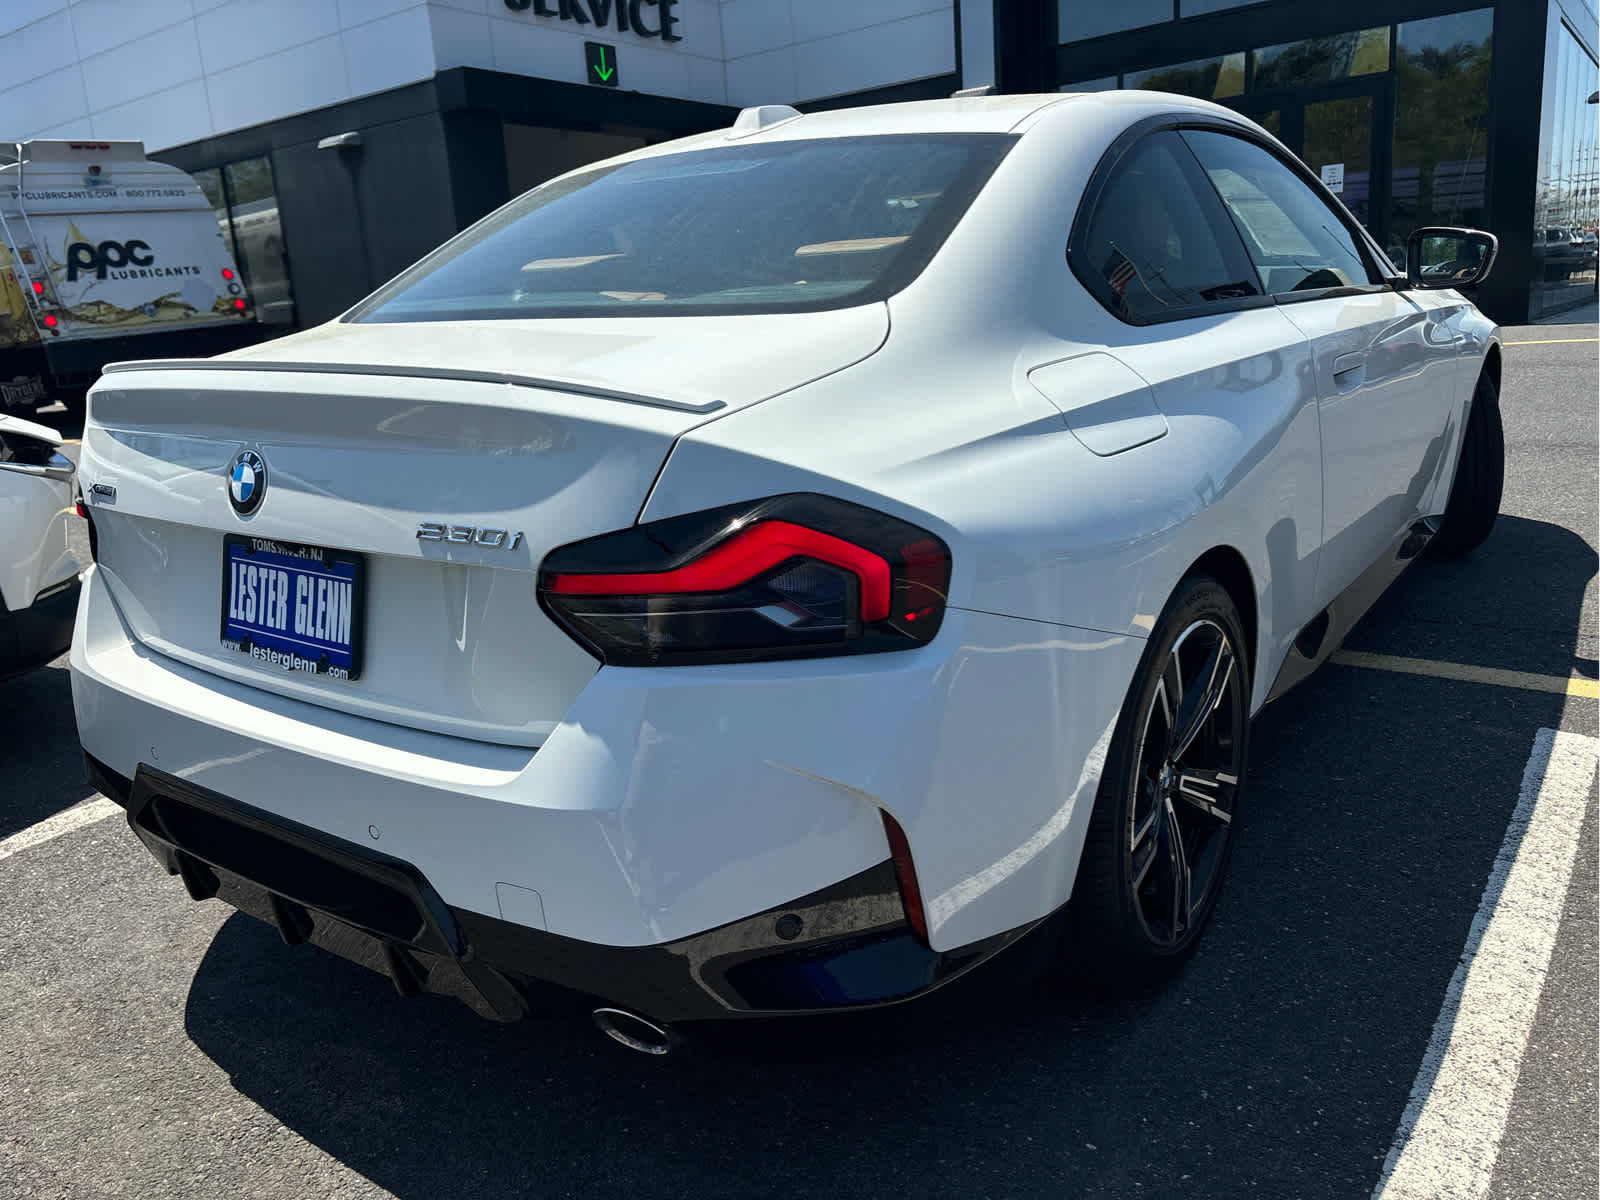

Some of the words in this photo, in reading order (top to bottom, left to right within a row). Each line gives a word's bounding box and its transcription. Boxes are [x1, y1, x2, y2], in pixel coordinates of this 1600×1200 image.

[503, 0, 683, 42] RVICE
[67, 240, 154, 282] ppc
[111, 265, 200, 281] LUBRICANTS
[251, 538, 276, 553] TOMS
[311, 546, 323, 561] NJ
[416, 520, 524, 551] 230i
[229, 562, 289, 631] LESTER
[294, 574, 352, 646] GLENN
[250, 642, 317, 674] lesterglenn
